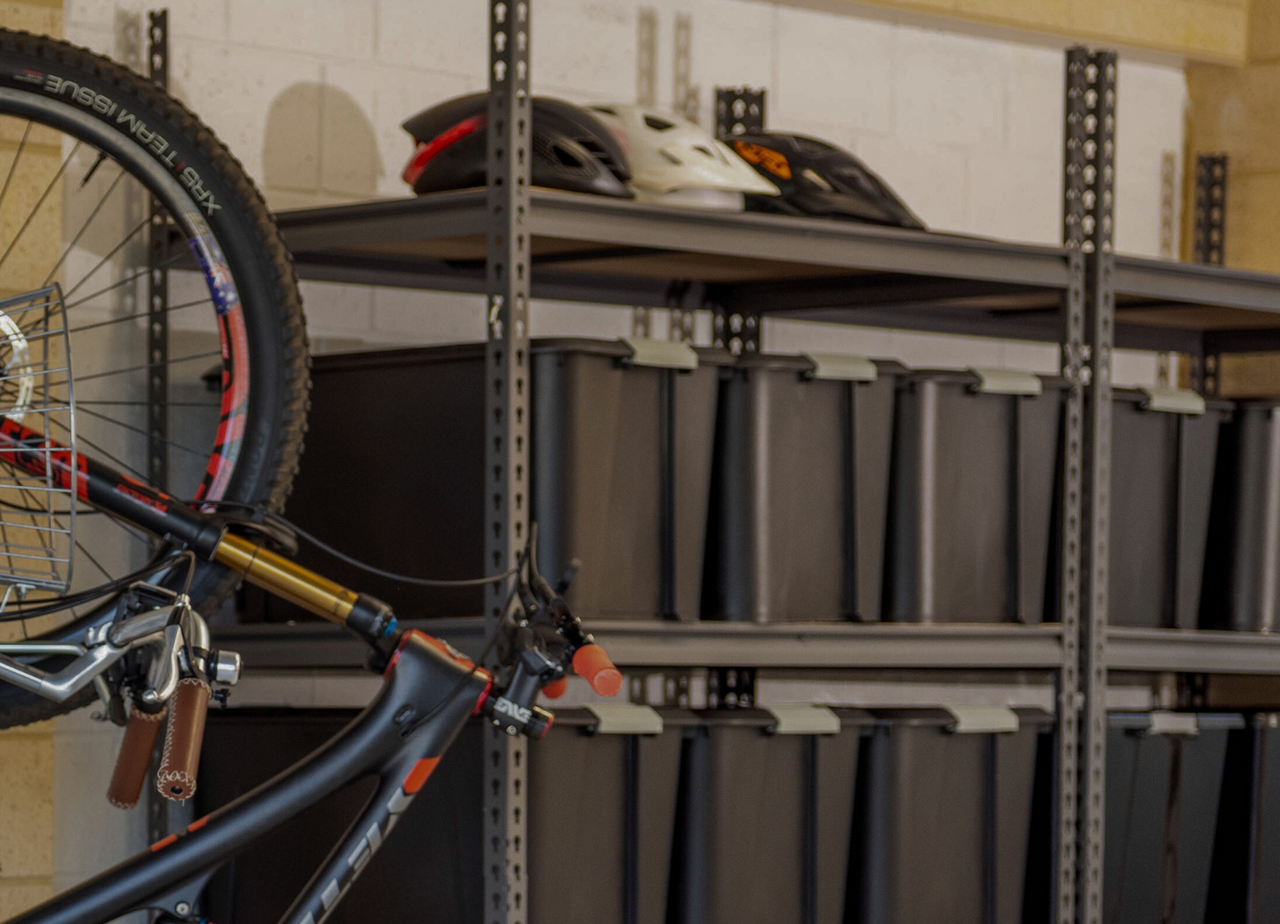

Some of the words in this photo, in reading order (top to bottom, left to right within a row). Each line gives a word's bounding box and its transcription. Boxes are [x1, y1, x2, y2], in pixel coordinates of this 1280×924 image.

[44, 73, 118, 118] ISSUE
[116, 108, 177, 168] TEAM
[179, 167, 222, 216] XR5
